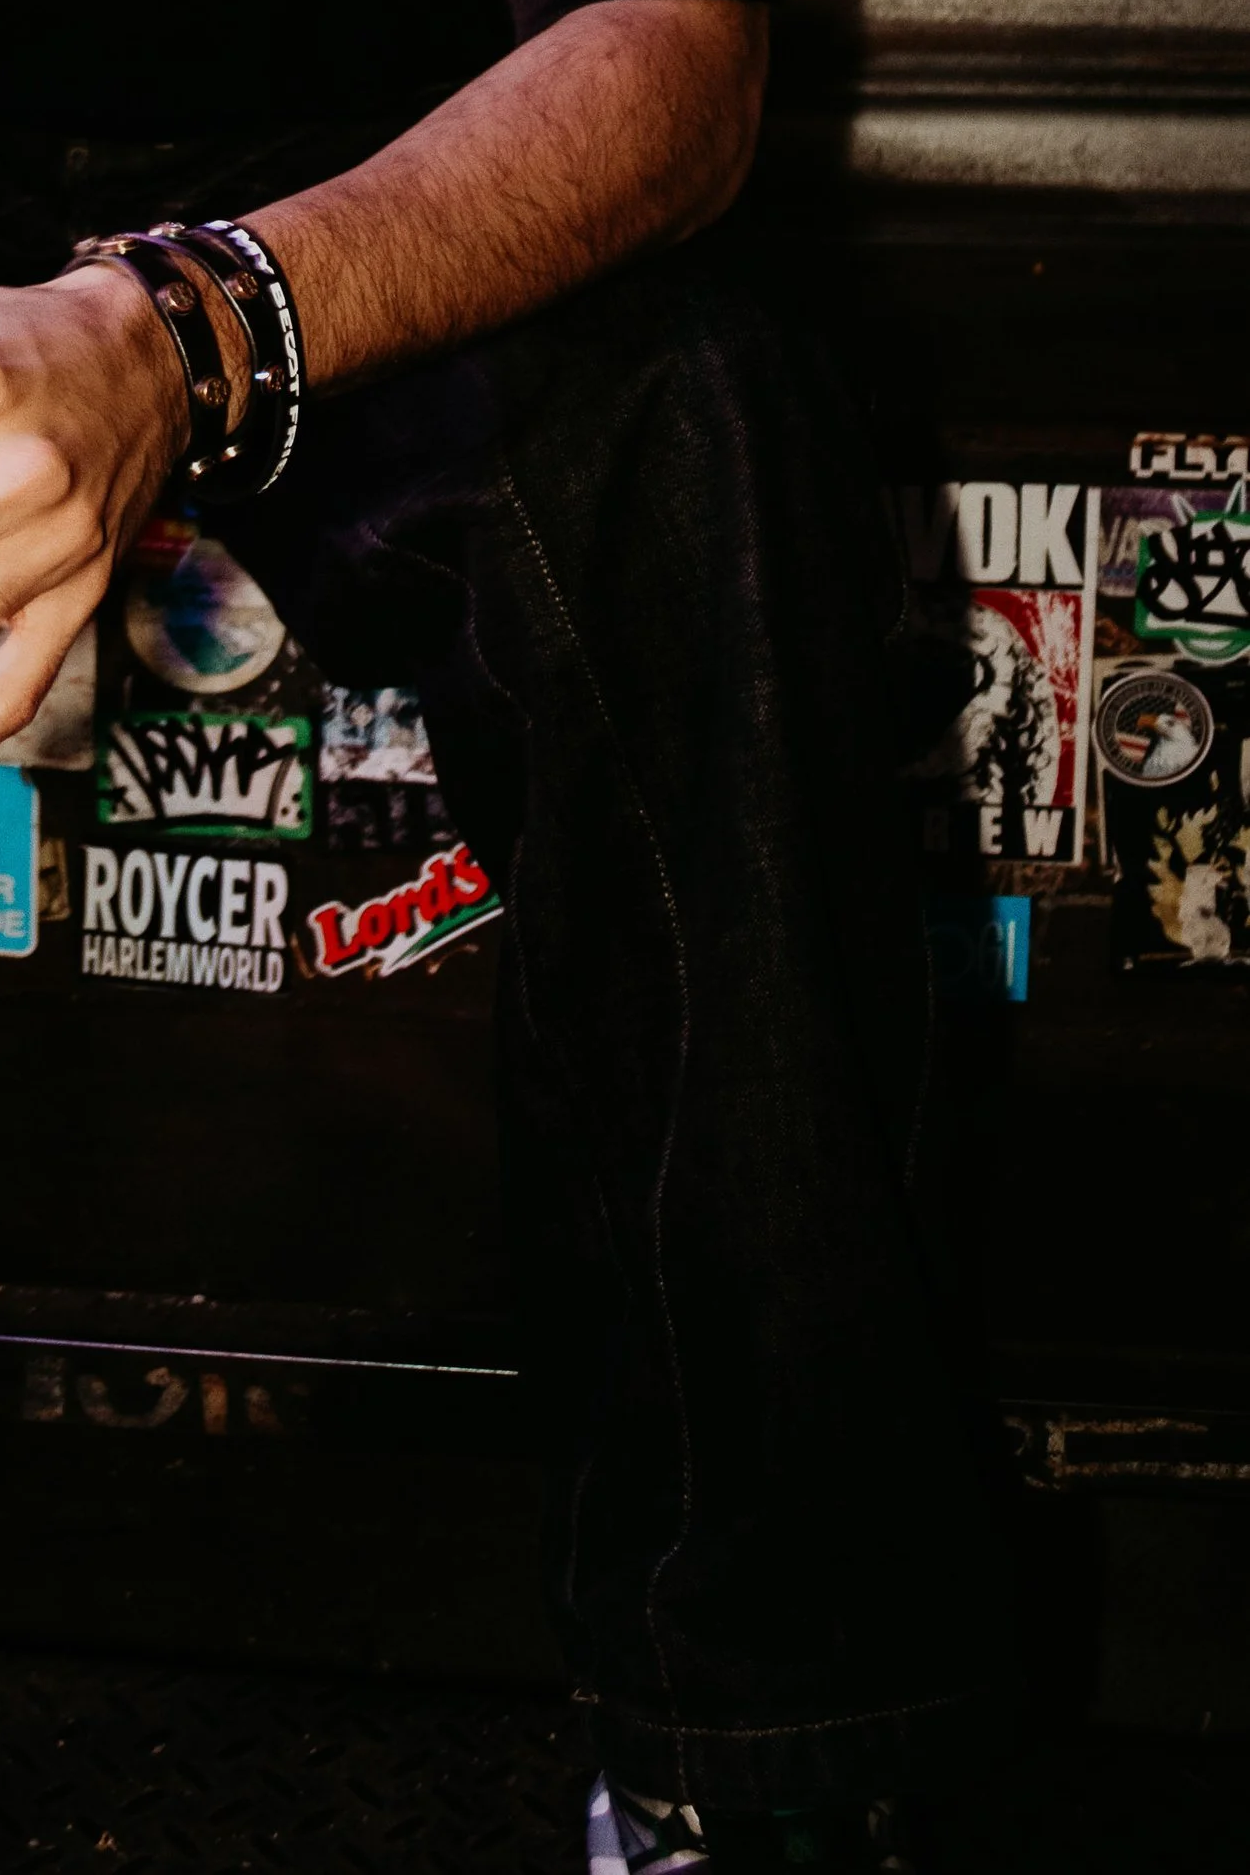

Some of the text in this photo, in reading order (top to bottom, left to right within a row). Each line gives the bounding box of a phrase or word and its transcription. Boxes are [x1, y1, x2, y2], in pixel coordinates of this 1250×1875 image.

[270, 281, 300, 397] BEST
[82, 843, 291, 951] ROYCER
[314, 844, 493, 968] Lords
